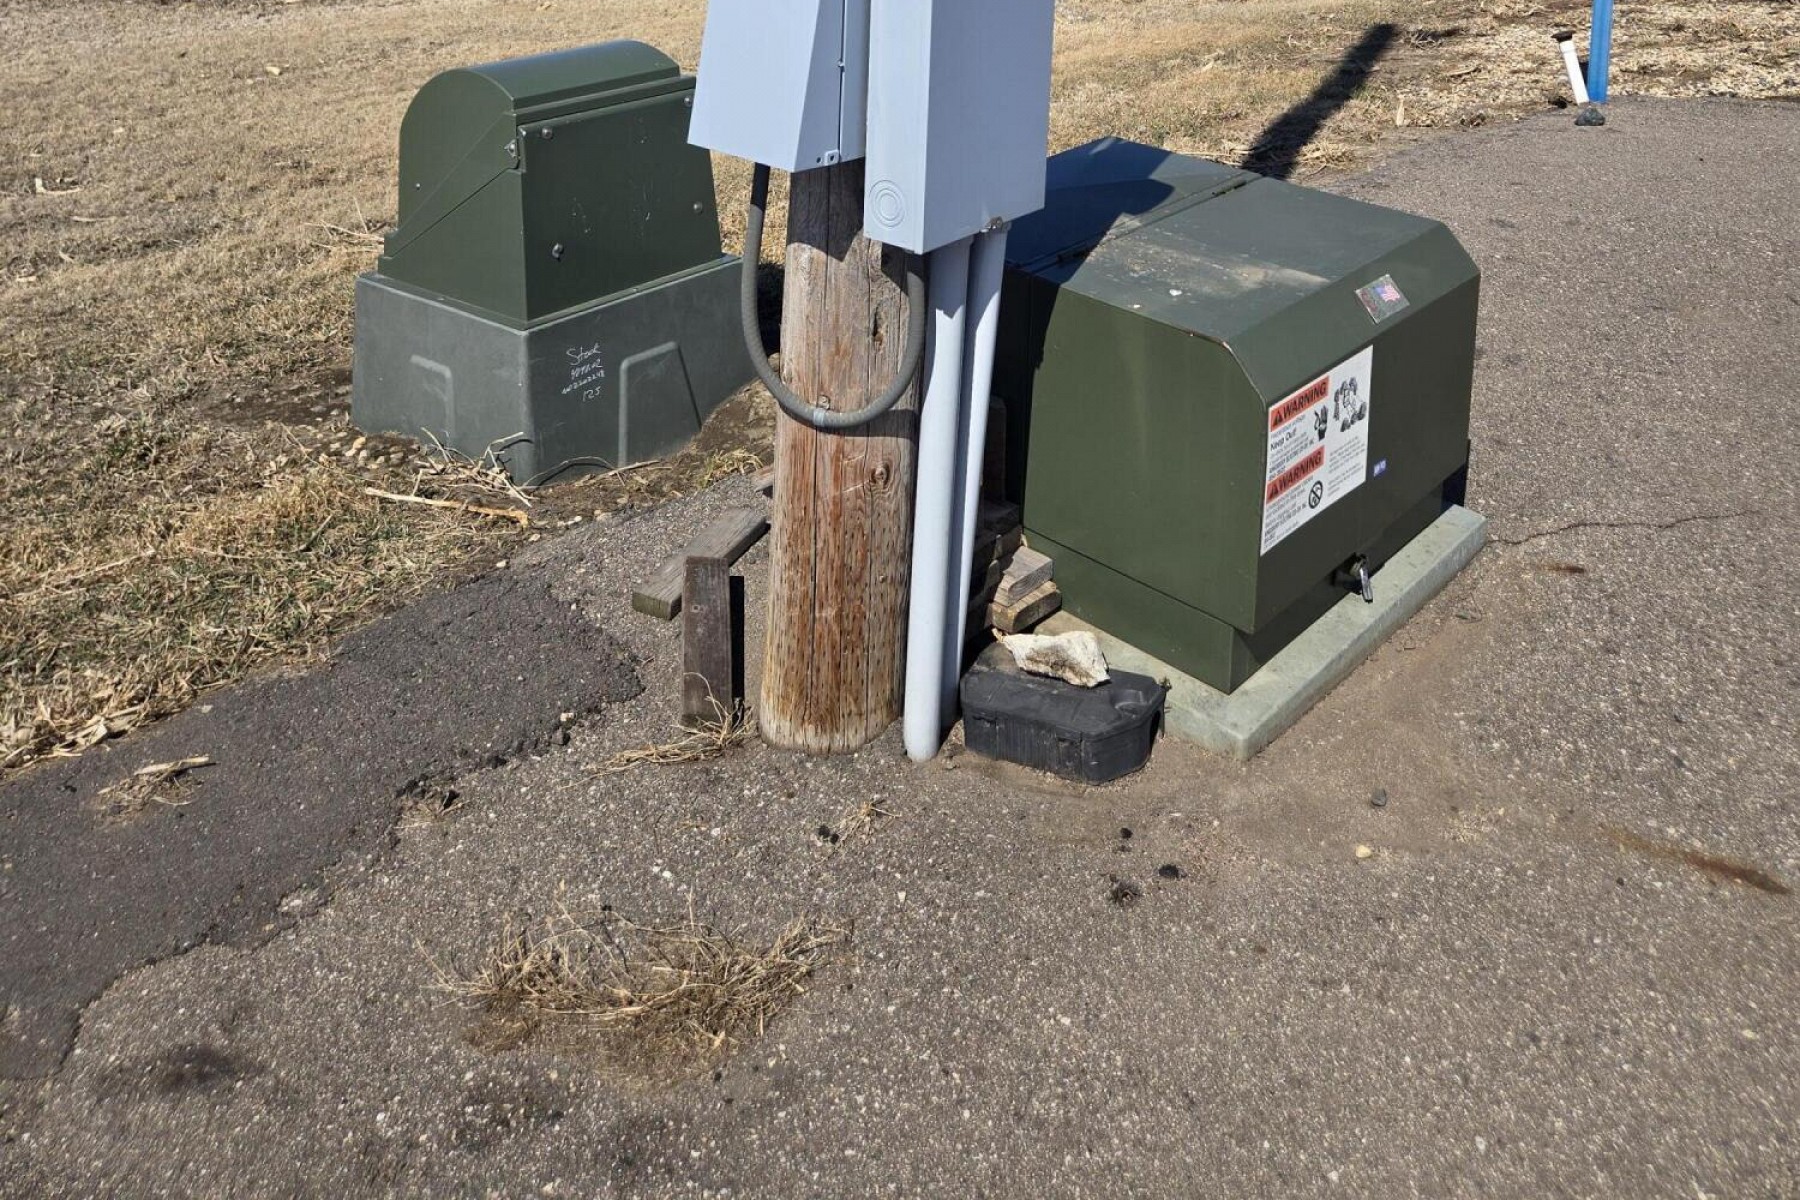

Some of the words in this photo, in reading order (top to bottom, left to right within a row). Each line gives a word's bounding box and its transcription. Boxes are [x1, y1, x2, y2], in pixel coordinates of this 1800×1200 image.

[1283, 381, 1327, 419] WARNING
[1270, 437, 1285, 451] Keep
[1278, 450, 1322, 489] WARNING
